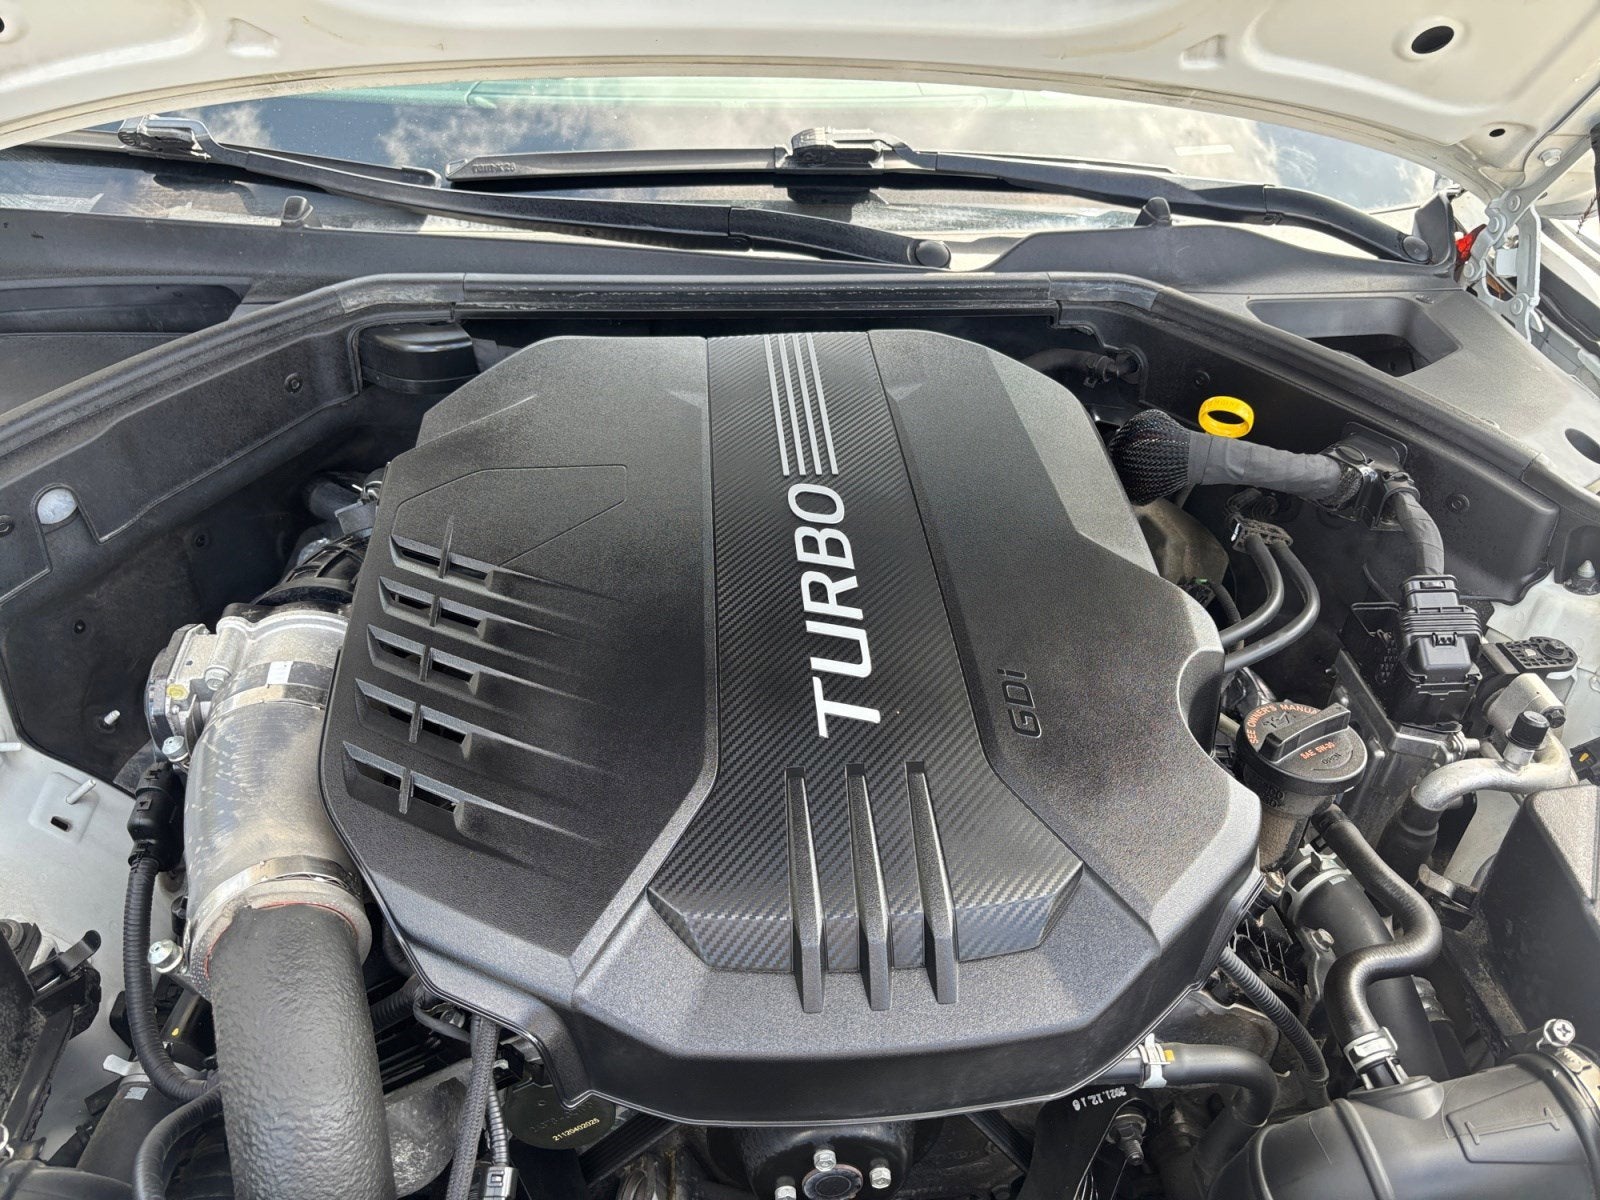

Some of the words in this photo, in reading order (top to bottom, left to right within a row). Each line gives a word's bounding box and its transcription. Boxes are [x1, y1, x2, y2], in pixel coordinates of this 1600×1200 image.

[787, 482, 881, 739] TURBO
[1247, 703, 1278, 728] OWNER'S
[1279, 704, 1319, 715] MANUA
[1246, 728, 1259, 744] SEE
[1300, 749, 1317, 760] SAE
